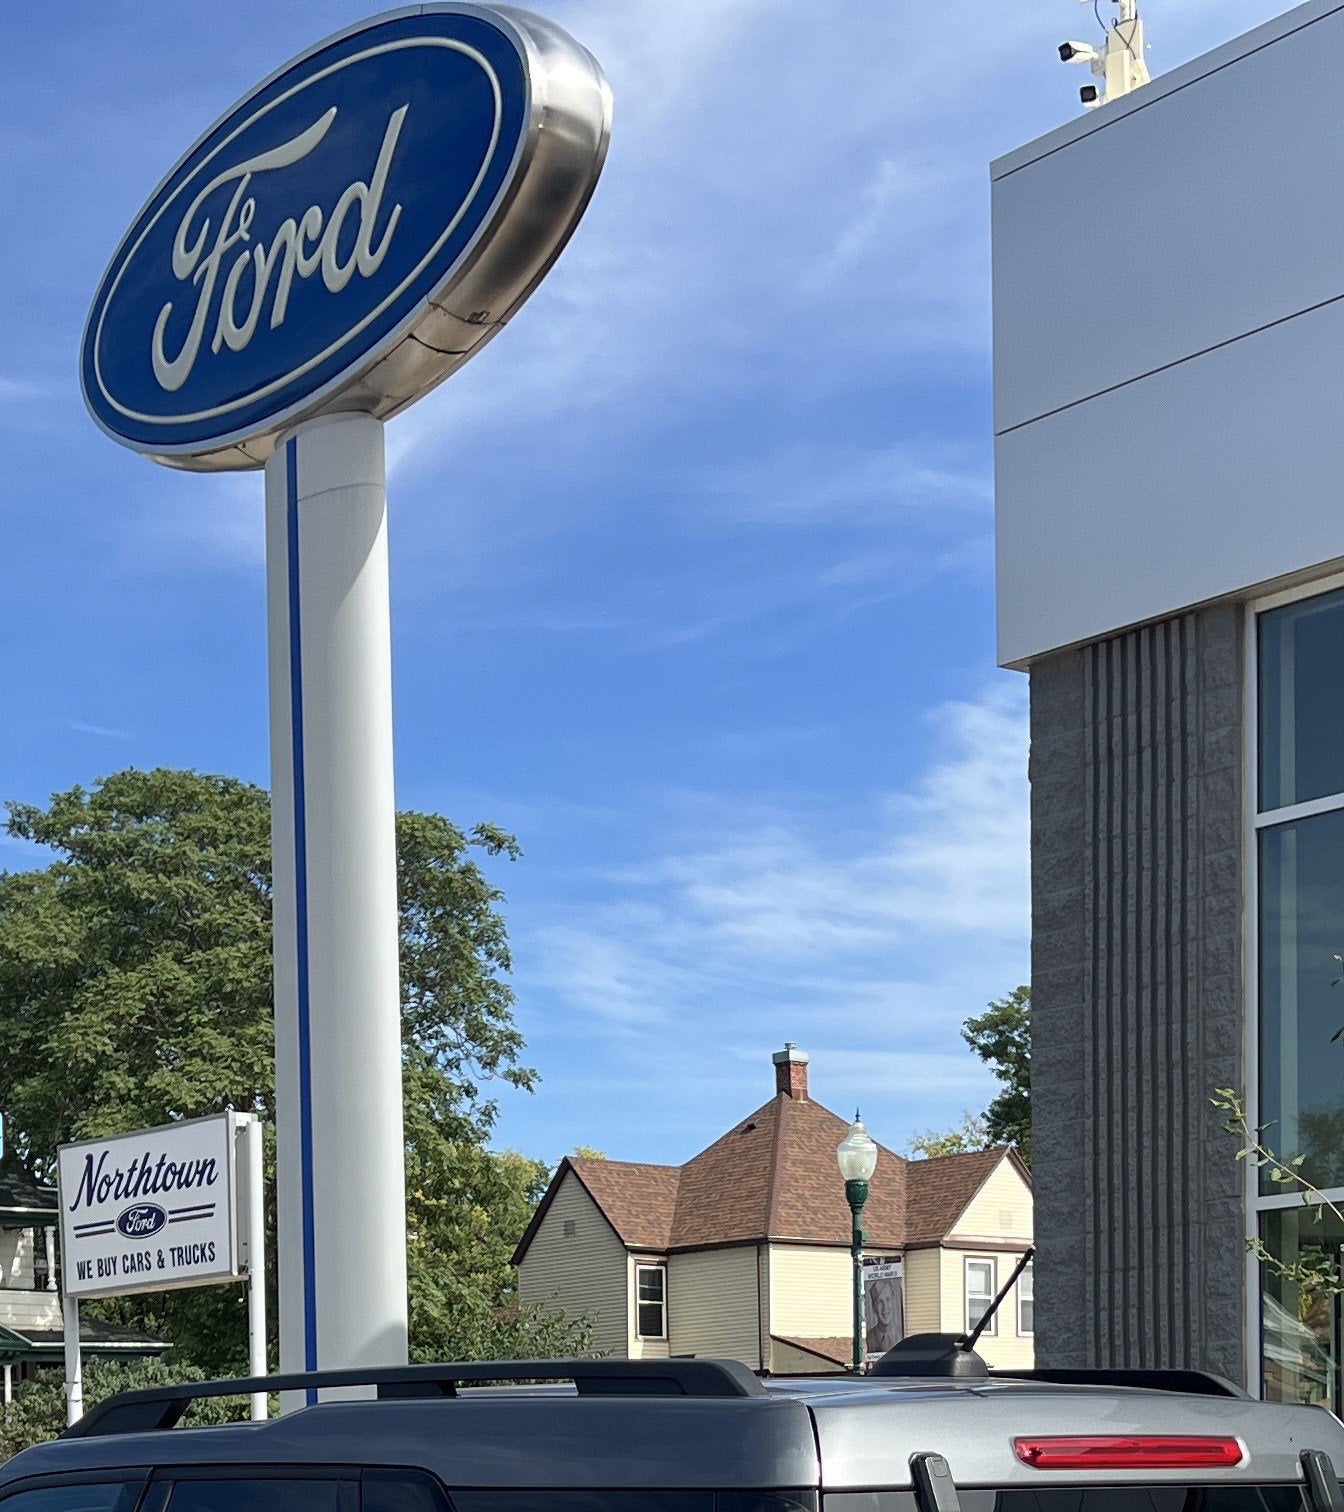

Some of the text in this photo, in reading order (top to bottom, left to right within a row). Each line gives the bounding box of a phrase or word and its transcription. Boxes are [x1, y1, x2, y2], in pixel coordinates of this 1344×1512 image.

[152, 103, 409, 391] Ford
[69, 1150, 219, 1212] Northtown
[125, 1208, 156, 1233] Ford
[76, 1241, 216, 1281] WE BUY CARS & TRUCKS
